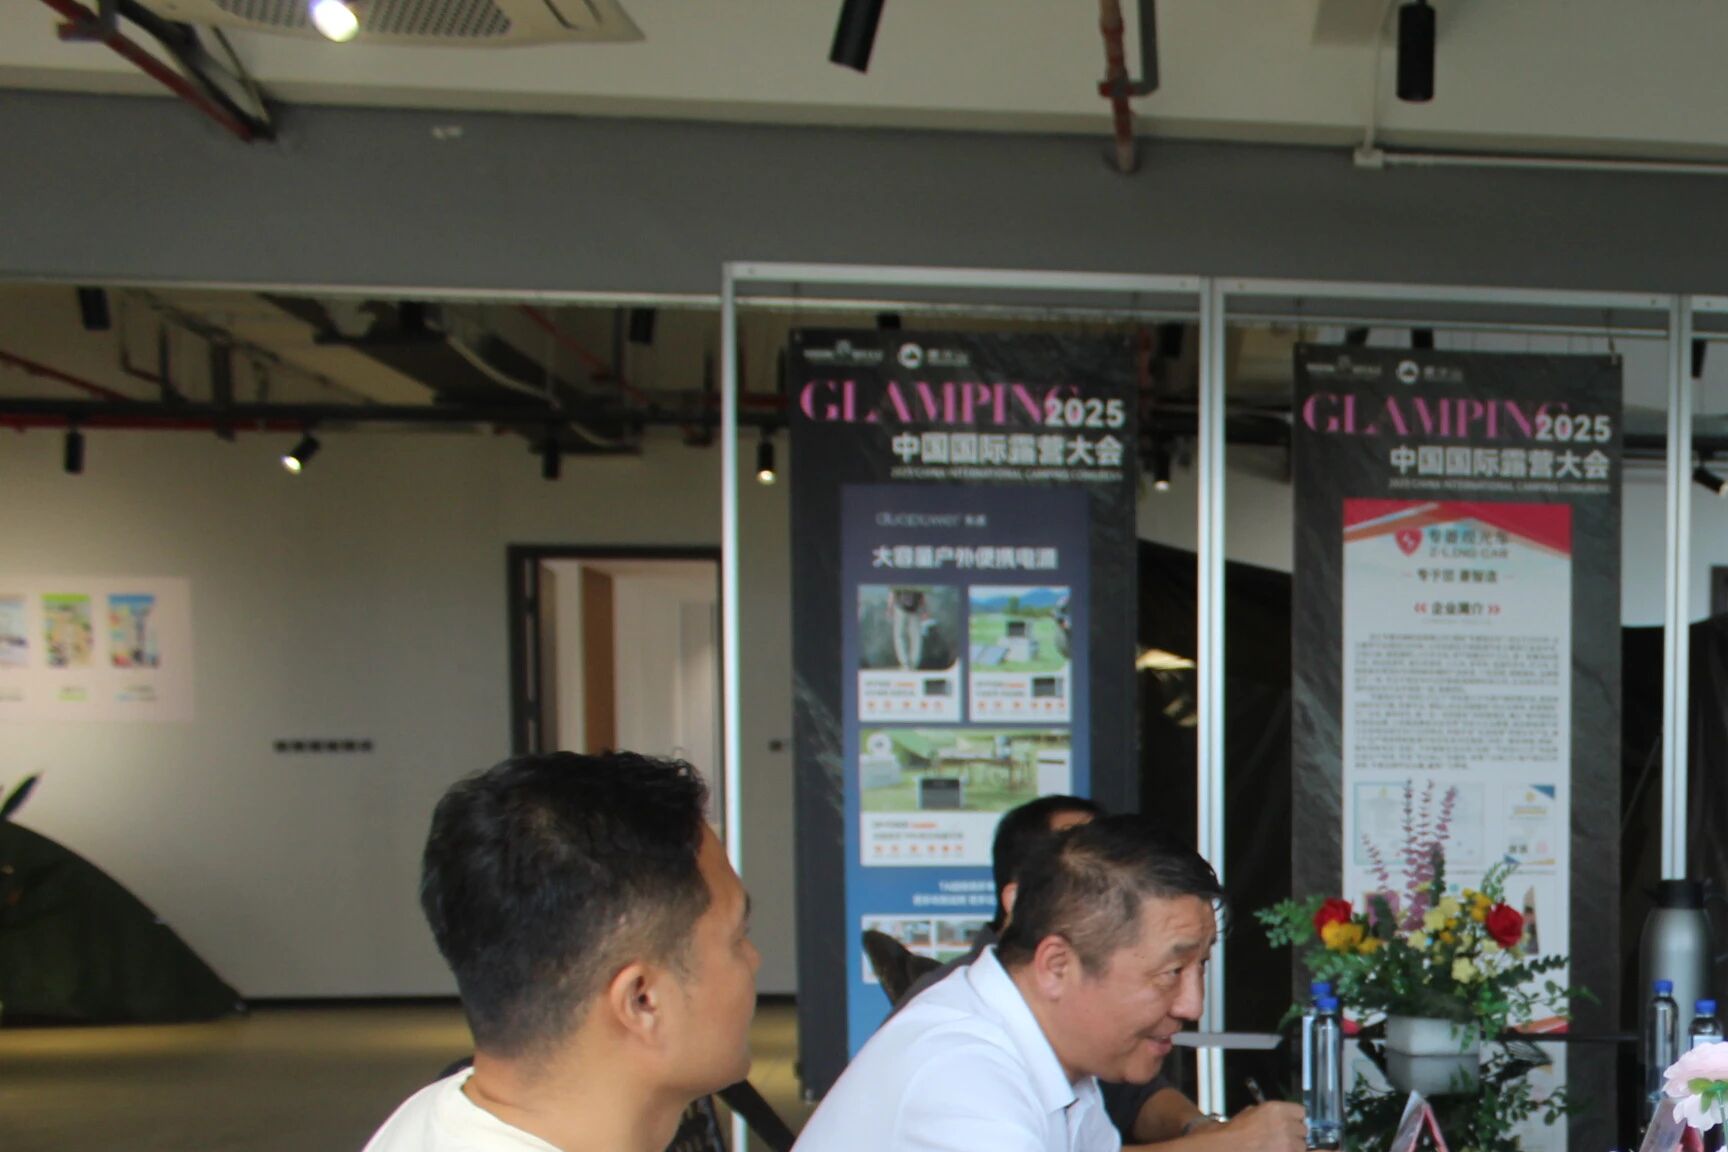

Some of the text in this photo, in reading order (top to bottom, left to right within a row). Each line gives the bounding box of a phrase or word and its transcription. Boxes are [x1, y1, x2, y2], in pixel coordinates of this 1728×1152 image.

[1045, 399, 1125, 427] 2025
[1535, 414, 1612, 442] 2025
[892, 432, 1124, 466] 中国国际露营大会
[1390, 446, 1610, 480] 中国国际露营大会
